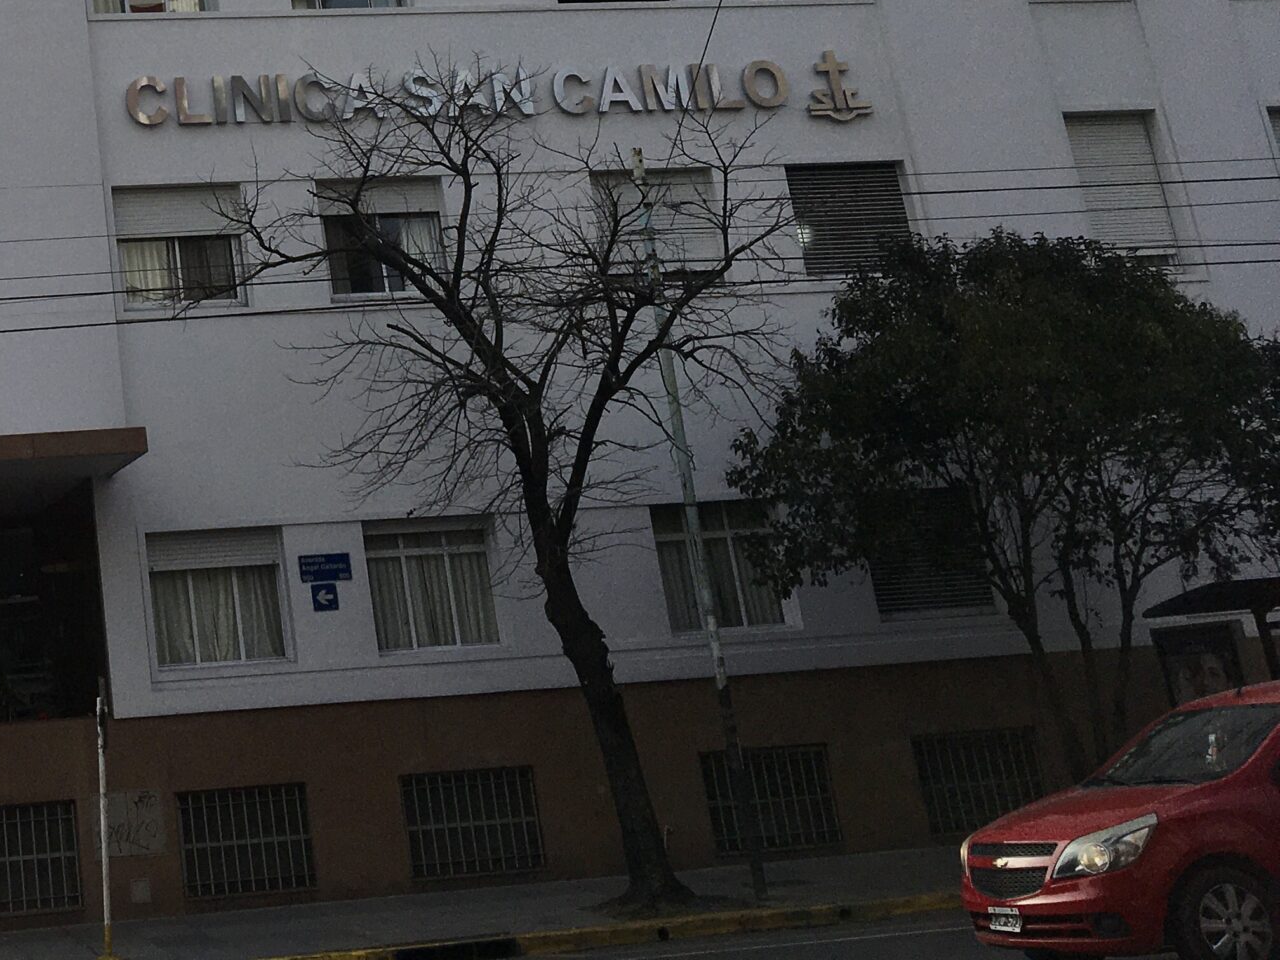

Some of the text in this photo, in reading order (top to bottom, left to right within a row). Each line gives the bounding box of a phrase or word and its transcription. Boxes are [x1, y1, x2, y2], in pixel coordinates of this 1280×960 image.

[125, 59, 789, 126] CLINICA SAN CAMILO
